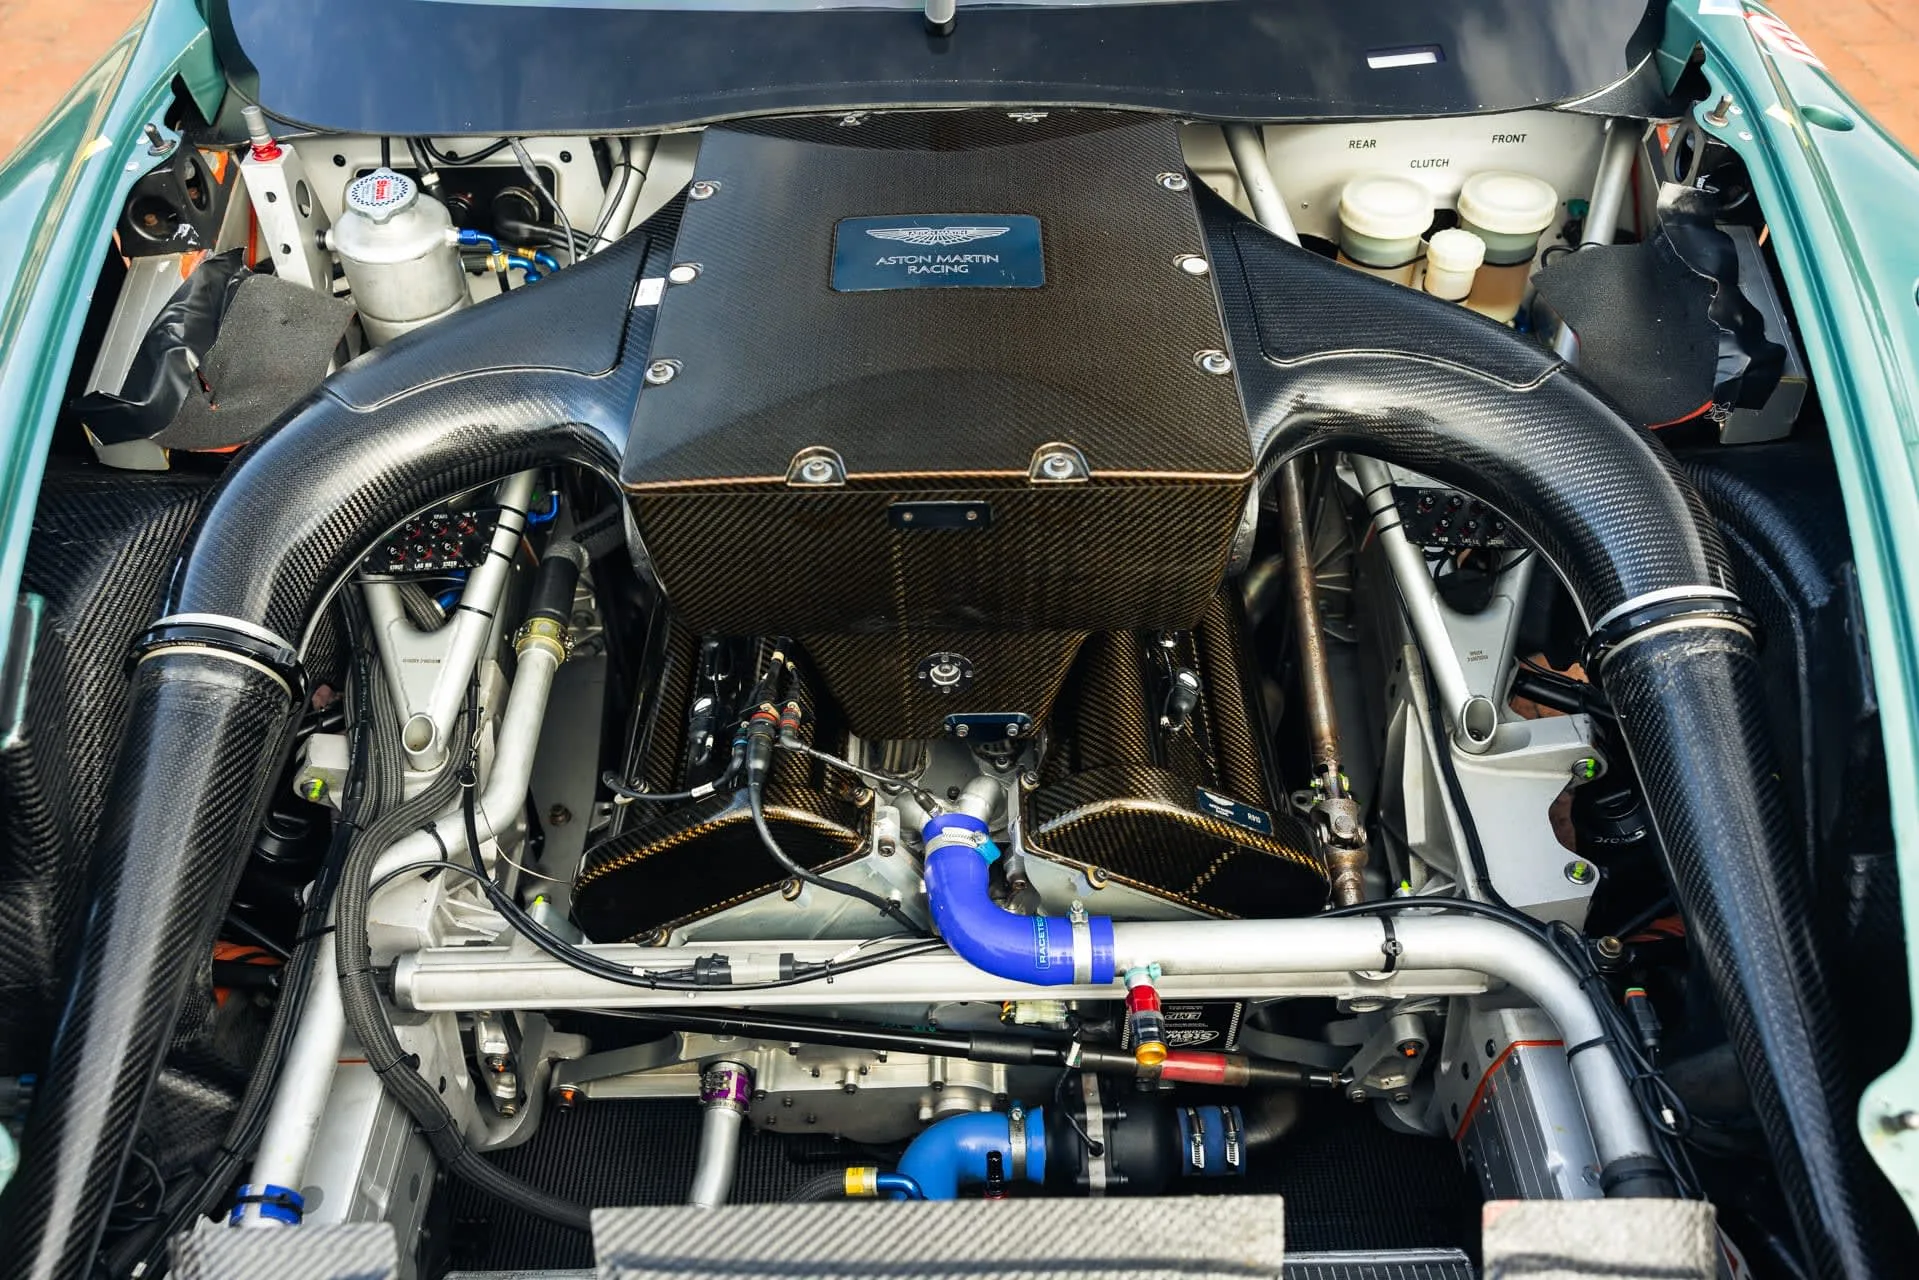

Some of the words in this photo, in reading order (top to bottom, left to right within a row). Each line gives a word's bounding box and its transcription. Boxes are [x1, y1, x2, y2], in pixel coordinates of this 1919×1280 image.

[1348, 139, 1377, 149] REAR
[1491, 133, 1527, 144] FRONT
[1410, 158, 1450, 169] CLUTCH
[875, 255, 932, 266] ASTON
[936, 254, 999, 263] MARTIN
[907, 264, 969, 275] RACING
